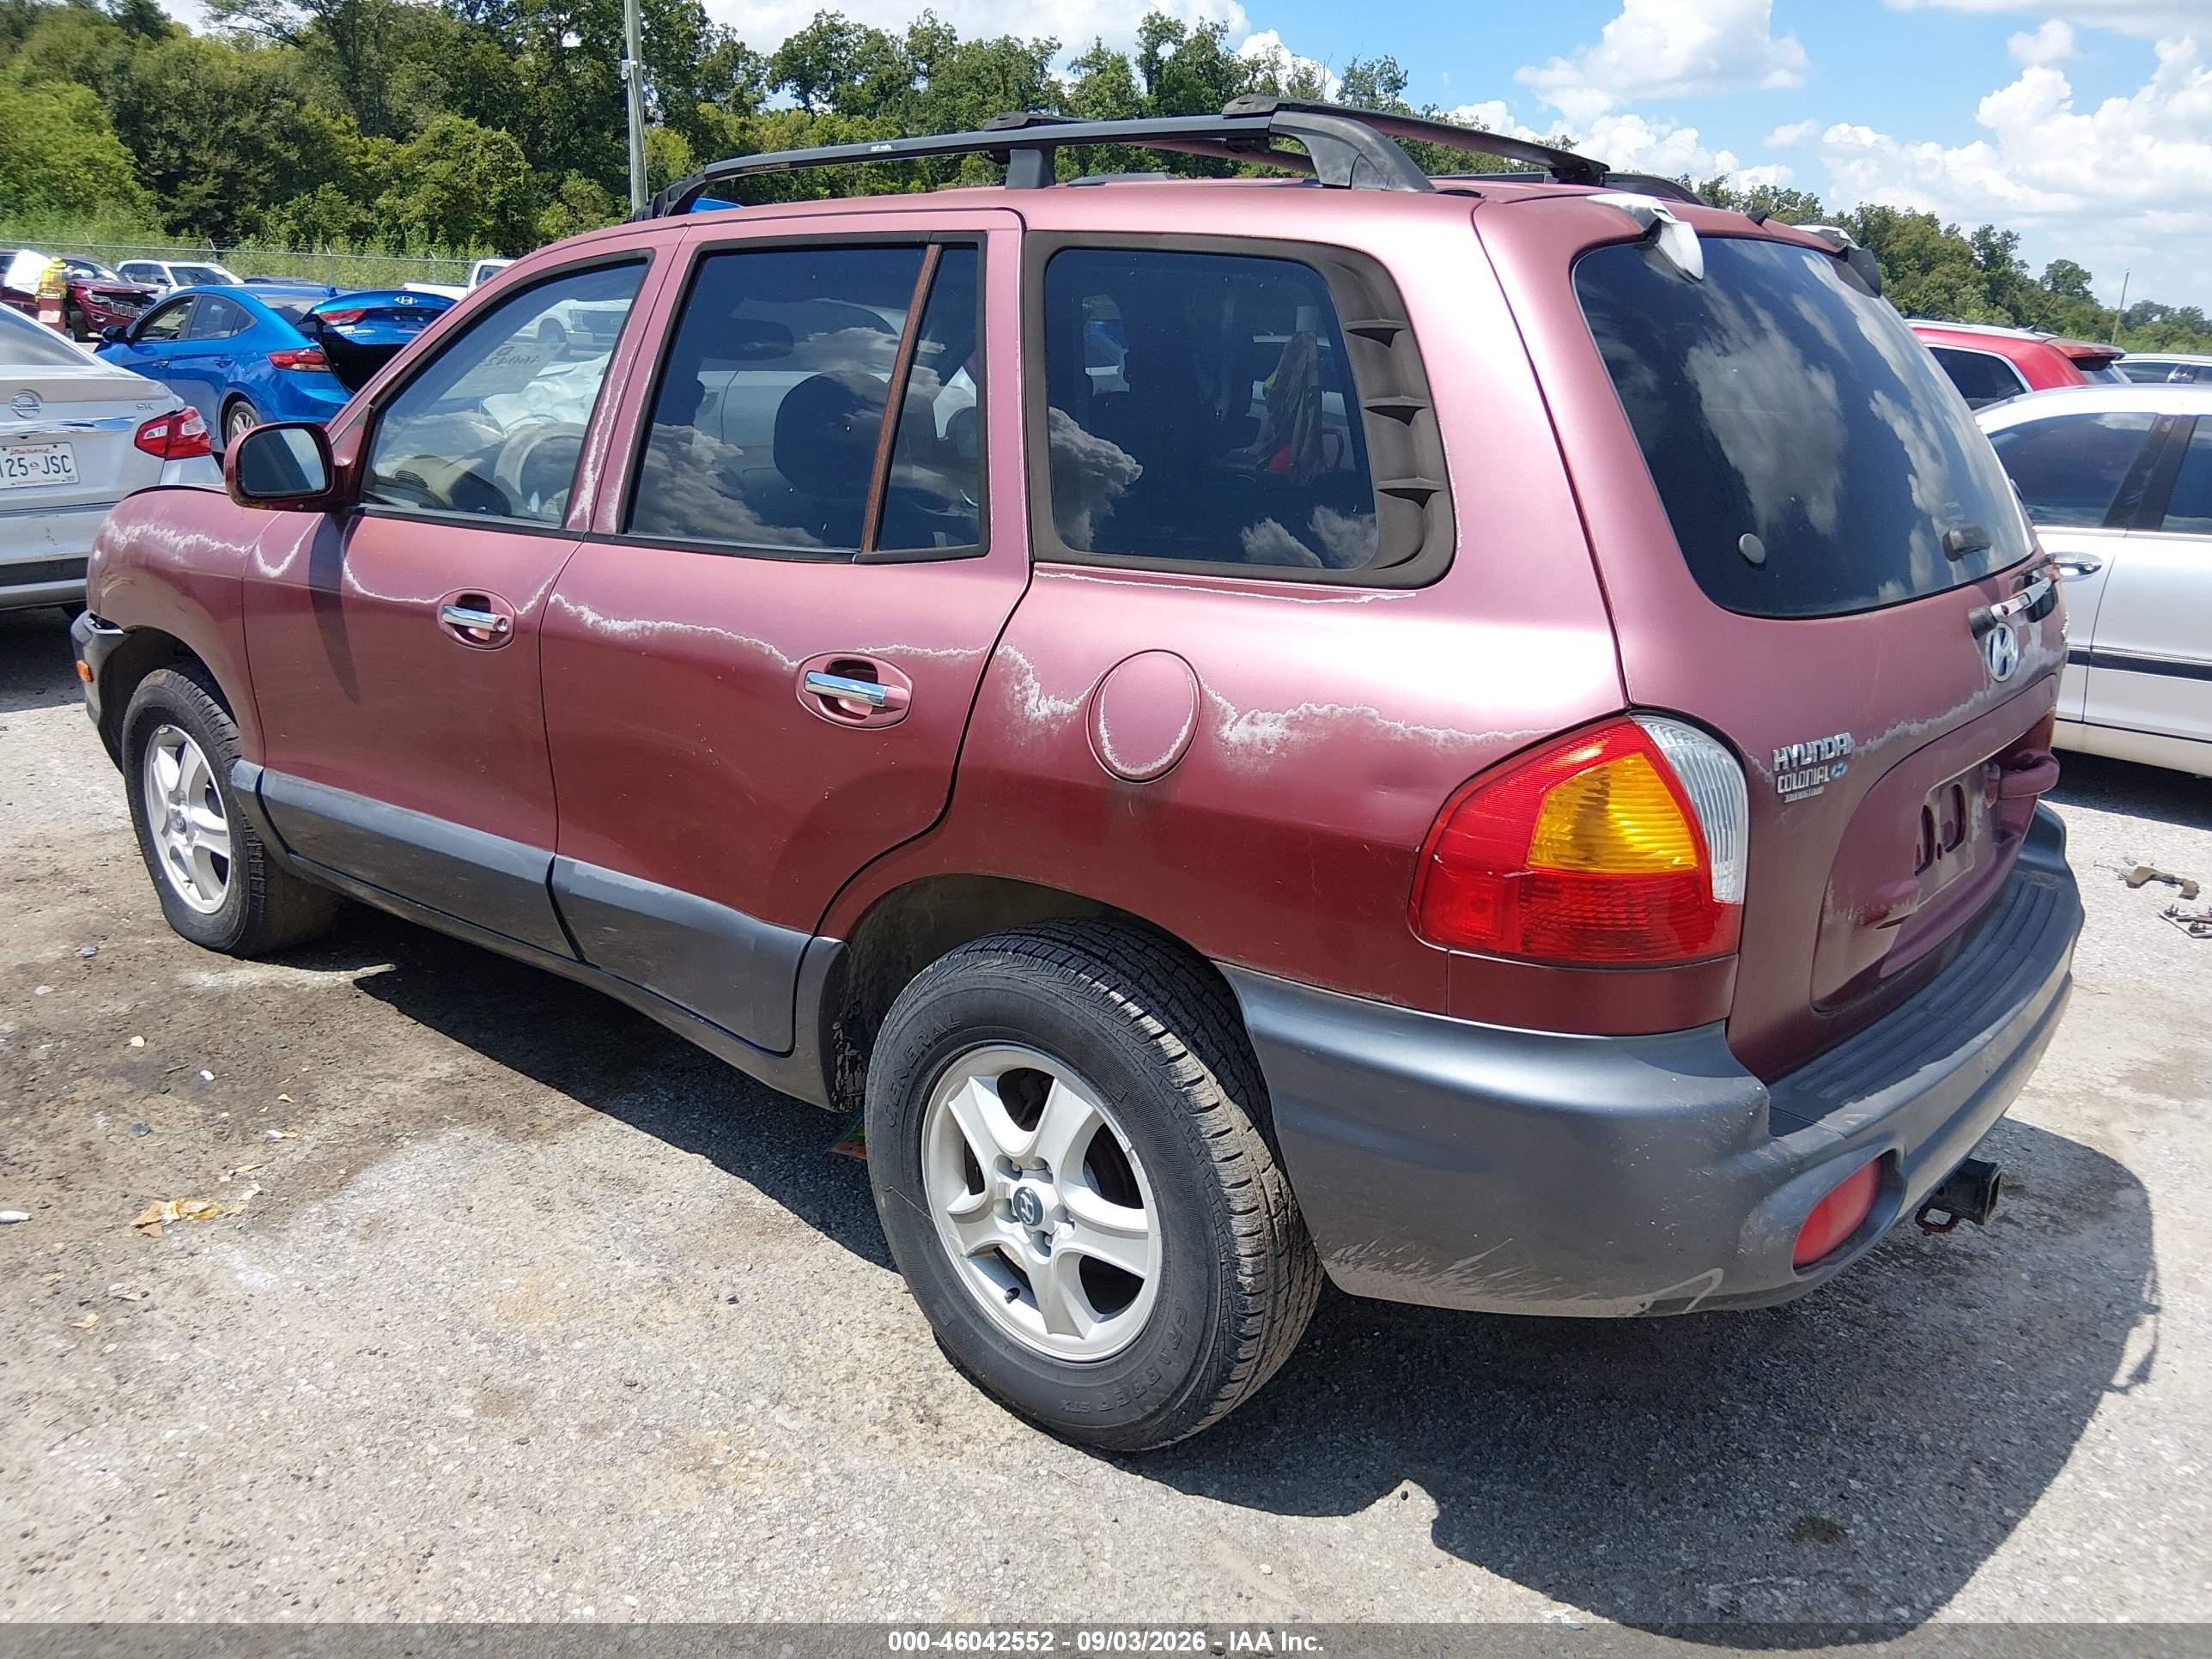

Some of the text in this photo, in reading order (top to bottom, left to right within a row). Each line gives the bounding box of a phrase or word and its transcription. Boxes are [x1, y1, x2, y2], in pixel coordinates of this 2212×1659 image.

[41, 454, 71, 474] JSC
[1777, 765, 1831, 794] COLONIAL
[885, 1012, 962, 1127] GENERAL
